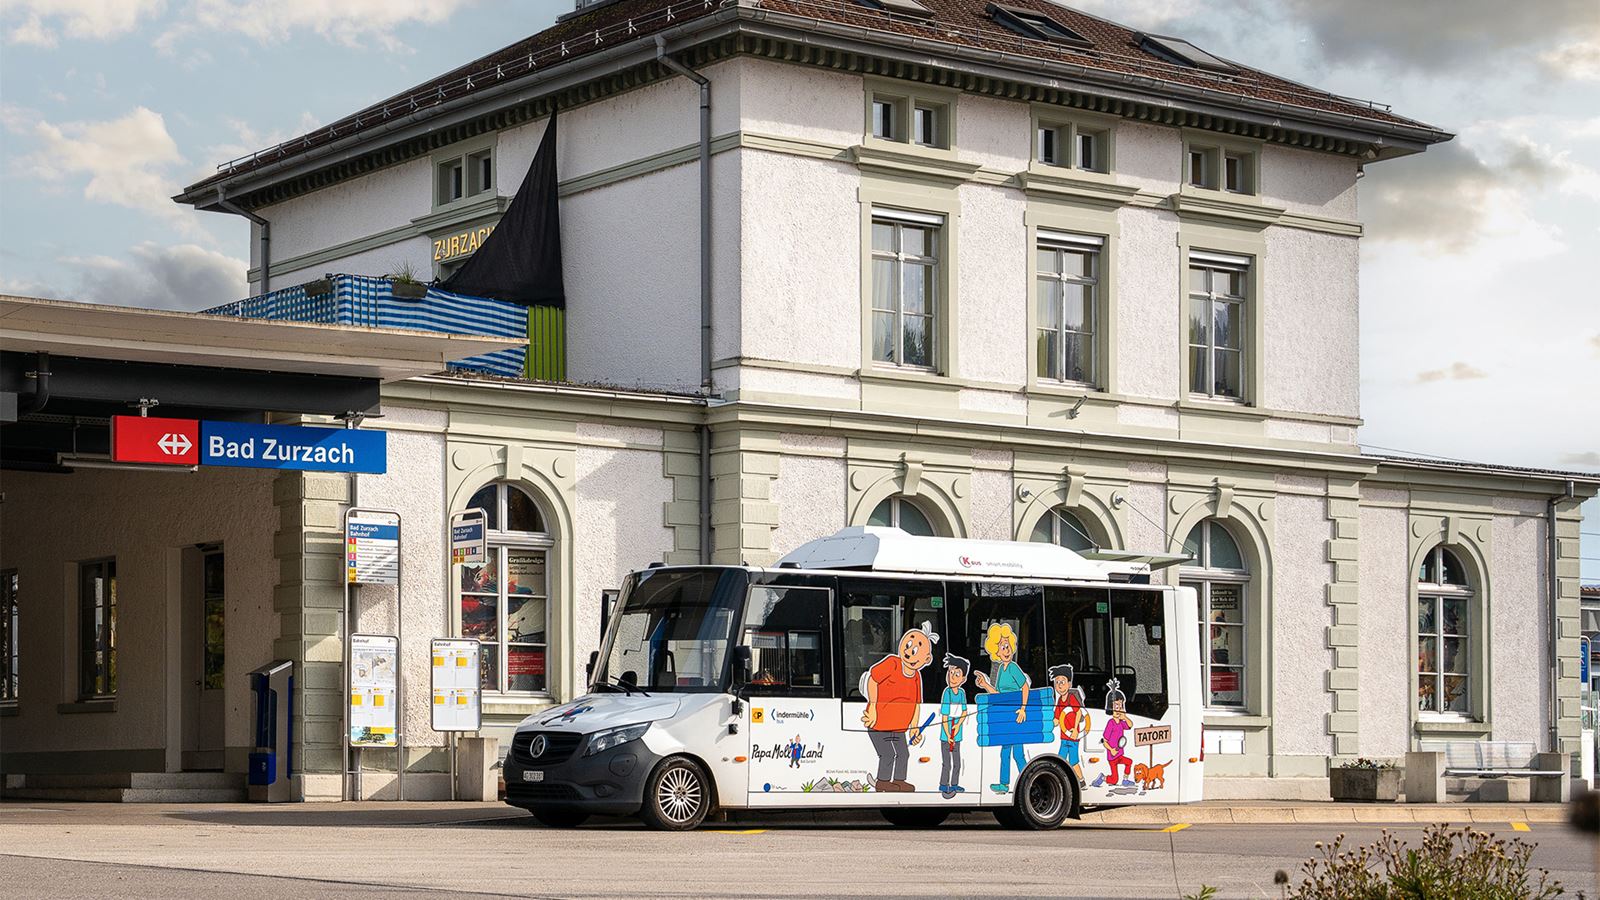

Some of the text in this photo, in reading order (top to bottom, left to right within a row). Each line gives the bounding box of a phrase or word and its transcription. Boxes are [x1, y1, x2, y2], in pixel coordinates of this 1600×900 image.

[434, 226, 495, 260] ZURZAC
[209, 436, 354, 464] Bad Zurzach
[963, 557, 970, 565] K
[776, 711, 809, 719] indermühle
[1137, 730, 1169, 742] TATORT
[751, 743, 771, 763] Papa
[801, 744, 824, 759] Land
